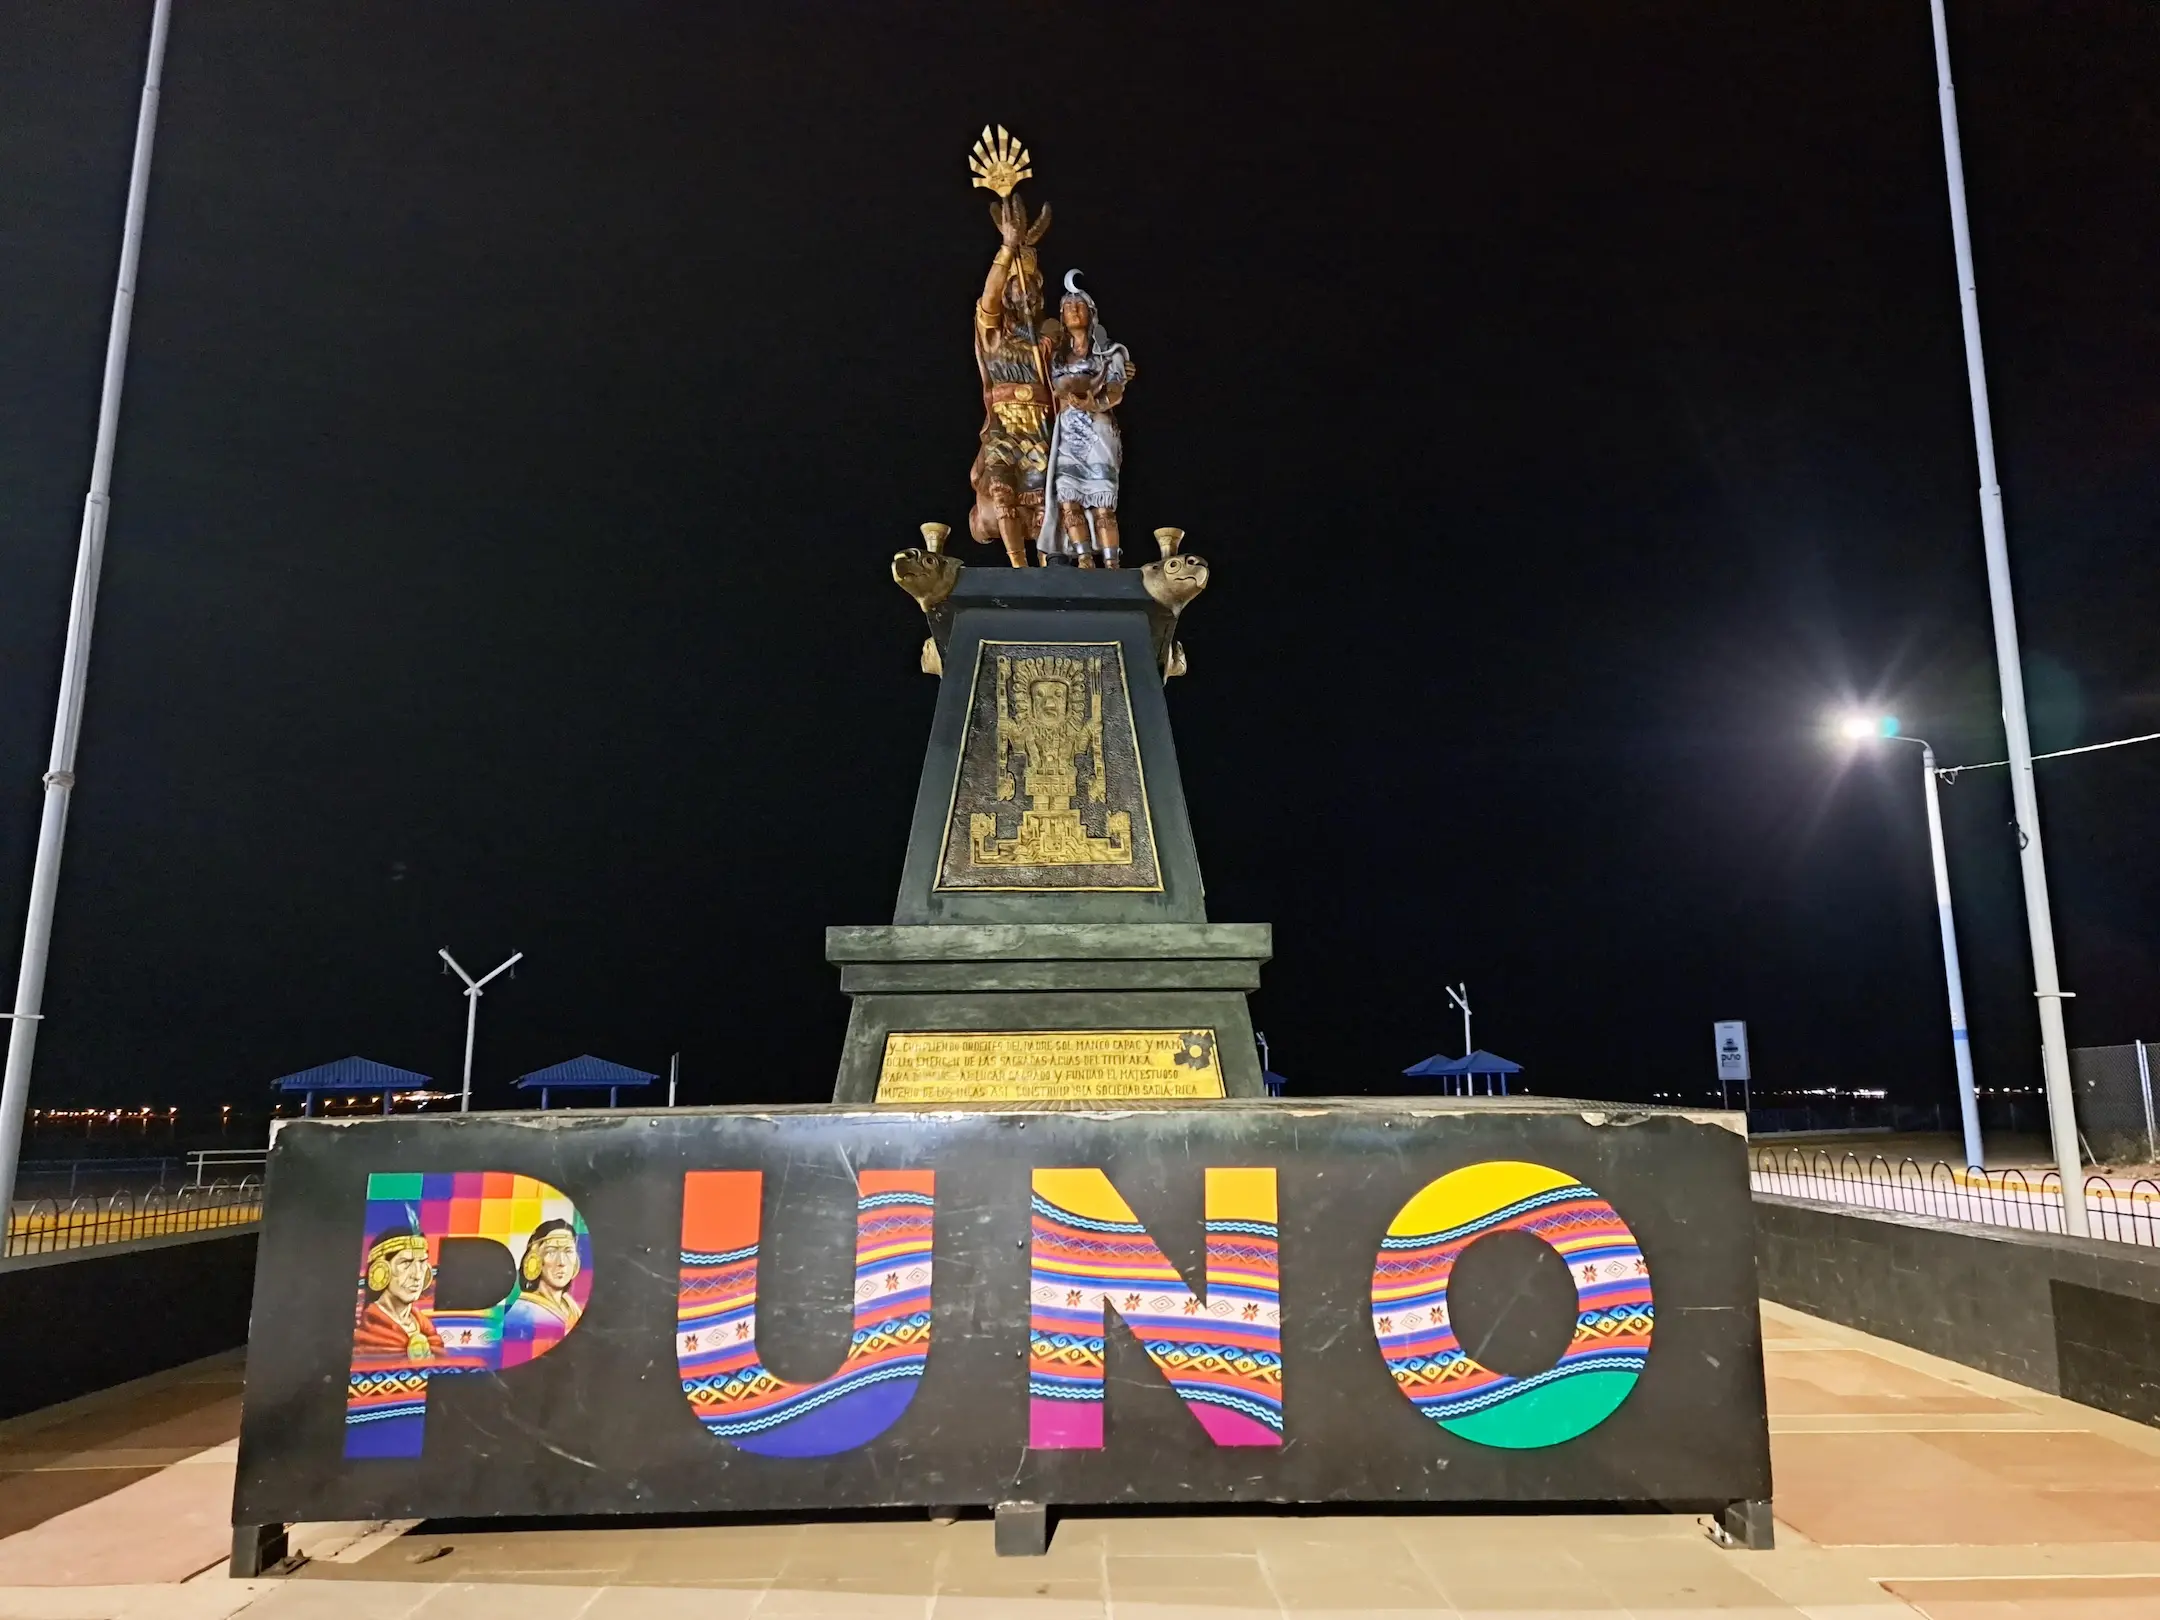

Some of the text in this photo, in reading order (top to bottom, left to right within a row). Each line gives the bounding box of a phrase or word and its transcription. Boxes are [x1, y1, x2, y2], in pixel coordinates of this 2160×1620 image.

[1006, 1041, 1022, 1051] DEL
[1024, 1041, 1053, 1051] PADRE
[1056, 1040, 1074, 1050] SOL
[1076, 1040, 1110, 1050] MANCO
[1113, 1040, 1142, 1050] CAPAC
[1144, 1039, 1154, 1053] Y
[964, 1056, 975, 1066] DE
[978, 1056, 997, 1066] LAS
[1050, 1055, 1080, 1065] AGUAS
[1083, 1055, 1099, 1065] DEL
[1101, 1054, 1153, 1065] TITIKAKA
[1054, 1069, 1063, 1084] Y
[1107, 1069, 1118, 1080] EL
[1120, 1069, 1179, 1081] MAJESTUOSO
[1095, 1084, 1140, 1096] SOCIEDAD
[1175, 1084, 1198, 1096] RICA
[343, 1161, 1654, 1458] PUNO
